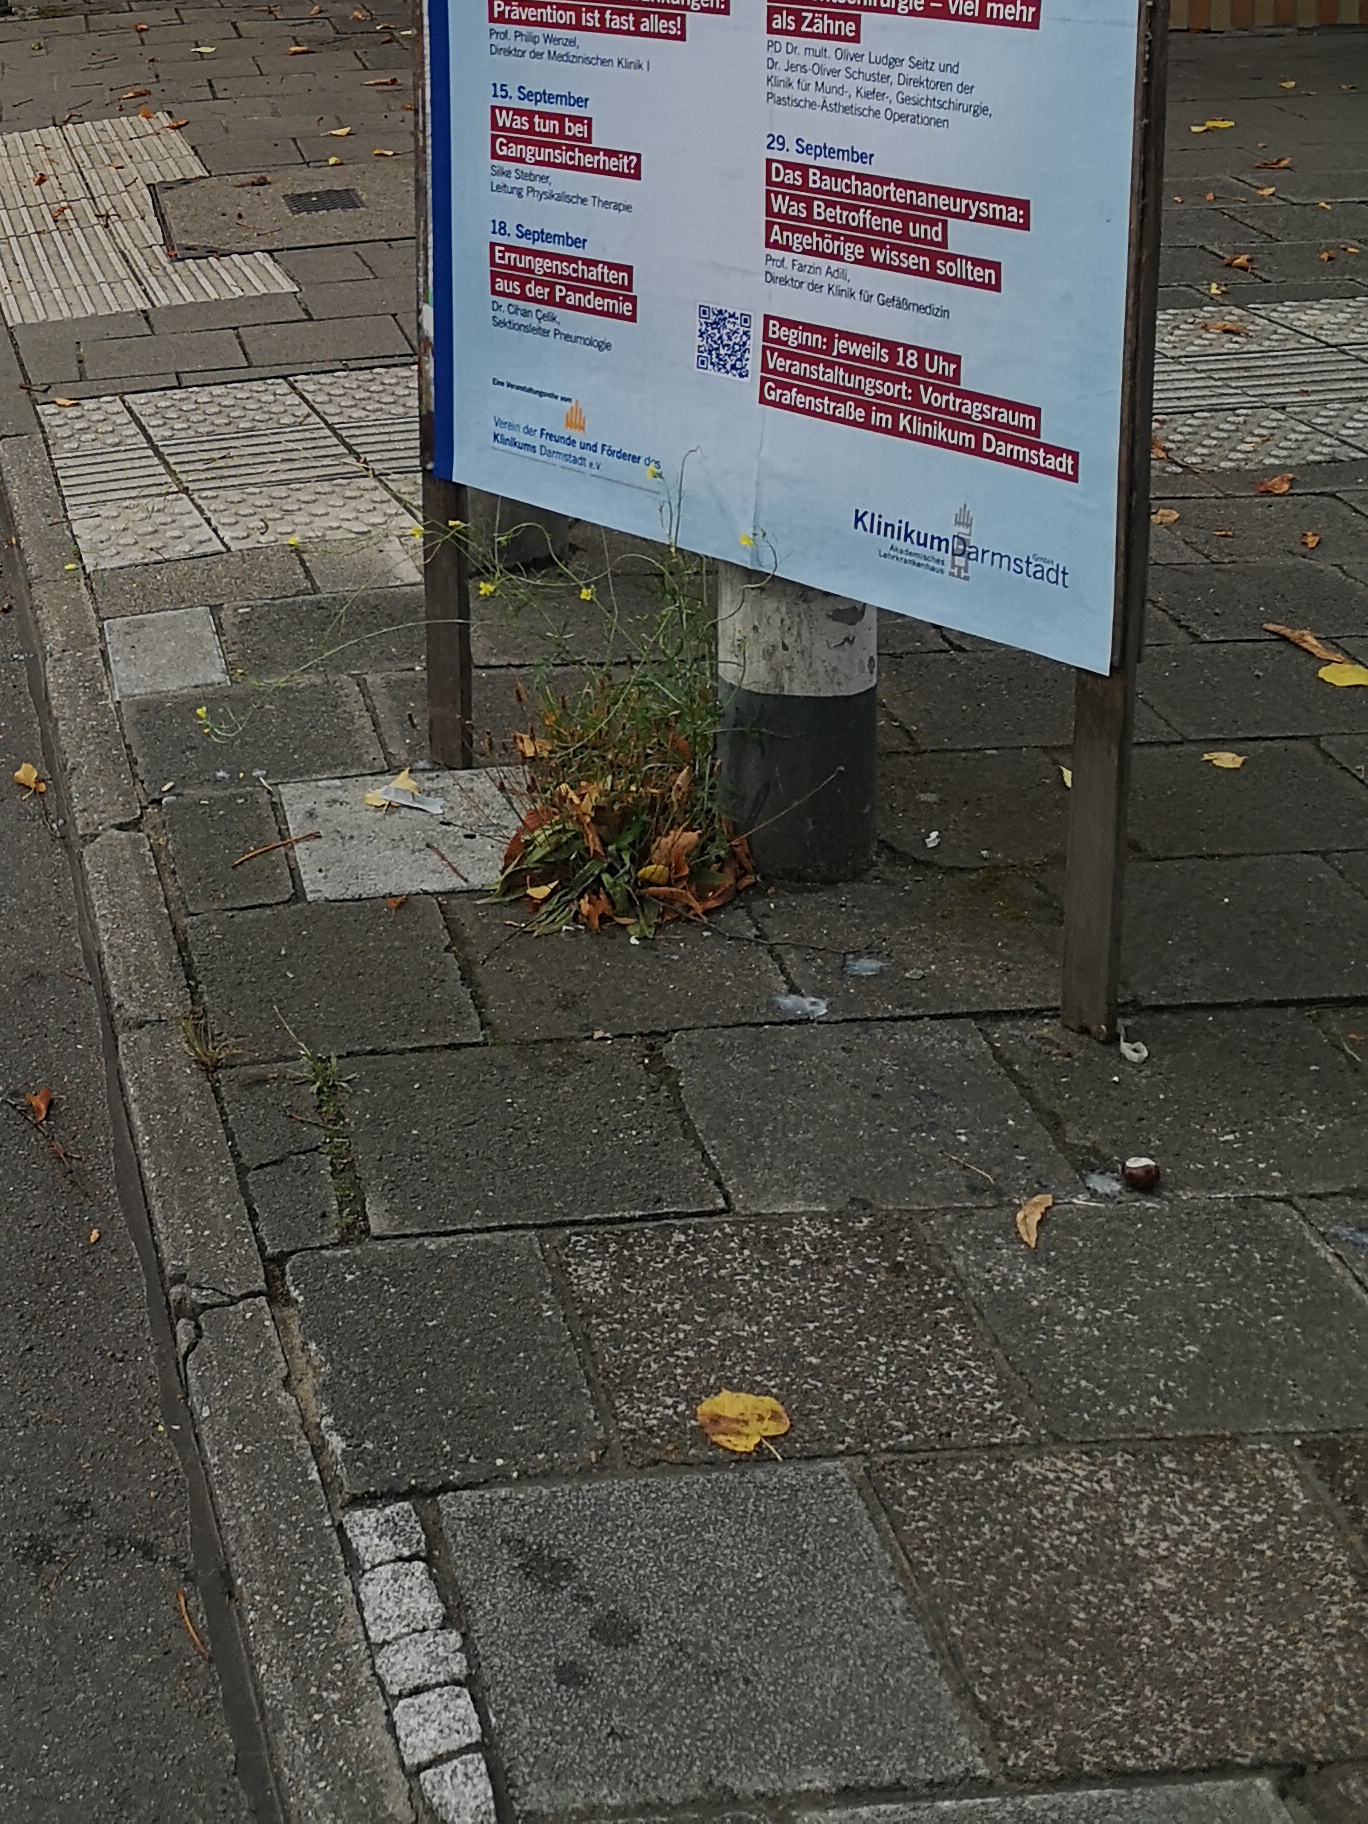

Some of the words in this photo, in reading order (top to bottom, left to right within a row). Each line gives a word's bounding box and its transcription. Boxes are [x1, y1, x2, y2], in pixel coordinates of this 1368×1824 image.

[493, 1, 575, 25] Prävention
[582, 8, 600, 27] ist
[605, 10, 635, 31] fast
[640, 15, 681, 34] alles!
[772, 13, 796, 31] als
[801, 14, 856, 36] Zähne
[986, 0, 1035, 22] mehr
[489, 28, 511, 41] Prof.
[543, 33, 580, 49] Wenzel,
[490, 45, 526, 59] Direktor
[532, 49, 544, 60] der
[547, 51, 614, 68] Medizinischen
[617, 57, 643, 71] Klinik
[767, 40, 782, 54] PD
[785, 42, 800, 56] Dr.
[804, 46, 831, 59] mult.
[834, 48, 865, 62] Oliver
[869, 52, 905, 70] Ludger
[908, 56, 935, 71] Seitz
[938, 60, 960, 75] und
[767, 58, 781, 71] Dr.
[784, 60, 841, 78] Jens-Oliver
[845, 67, 893, 86] Schuster,
[897, 73, 953, 92] Direktoren
[957, 81, 974, 95] der
[492, 83, 512, 100] 15.
[518, 86, 589, 108] September
[767, 75, 794, 90] Klinik
[797, 79, 811, 92] für
[815, 81, 851, 100] Mund-,
[856, 86, 892, 104] Kiefer-,
[896, 91, 992, 118] Gesichtschirurgie,
[767, 92, 880, 119] Plastische-Ästhetische
[884, 108, 949, 129] Operationen
[495, 109, 529, 129] Was
[534, 114, 559, 134] tun
[565, 117, 588, 138] bei
[495, 138, 637, 174] Gangunsicherheit?
[766, 134, 790, 153] 29.
[795, 138, 874, 166] September
[490, 181, 523, 198] Leitung
[526, 186, 588, 207] Physikalische
[592, 195, 632, 214] Therapie
[771, 163, 802, 186] Das
[808, 168, 1024, 224] Bauchaortenaneurysma:
[491, 220, 511, 237] 18.
[516, 224, 587, 250] September
[771, 194, 806, 217] Was
[813, 200, 902, 235] Betroffene
[909, 218, 942, 242] und
[495, 246, 628, 285] Errungenschaften
[765, 254, 786, 269] Prof.
[792, 258, 822, 276] Farzin
[770, 225, 864, 262] Angehörige
[870, 244, 930, 272] wissen
[936, 257, 996, 285] sollten
[492, 301, 504, 313] Dr.
[495, 277, 521, 295] aus
[525, 281, 550, 300] der
[555, 285, 633, 316] Pandemie
[764, 271, 804, 289] Direktor
[807, 280, 823, 294] der
[828, 284, 856, 301] Klinik
[860, 290, 873, 304] für
[877, 293, 950, 320] Gefäßmedizin
[492, 316, 550, 338] Sektionsleiter
[553, 329, 612, 352] Pneumologie
[768, 320, 827, 350] Beginn:
[833, 334, 889, 363] jeweils
[897, 347, 918, 369] 18
[925, 353, 957, 378] Uhr
[766, 350, 913, 400] Veranstaltungsort:
[920, 384, 1036, 431] Vortragsraum
[493, 416, 520, 432] Verein
[523, 424, 538, 437] der
[540, 429, 576, 448] Freunde
[579, 439, 597, 453] und
[601, 444, 641, 464] Förderer
[764, 382, 866, 423] Grafenstraße
[871, 406, 892, 429] im
[898, 413, 976, 449] Klinikum
[982, 433, 1074, 475] Darmstadt
[493, 433, 537, 454] Klinikums
[539, 444, 587, 468] Darmstadt
